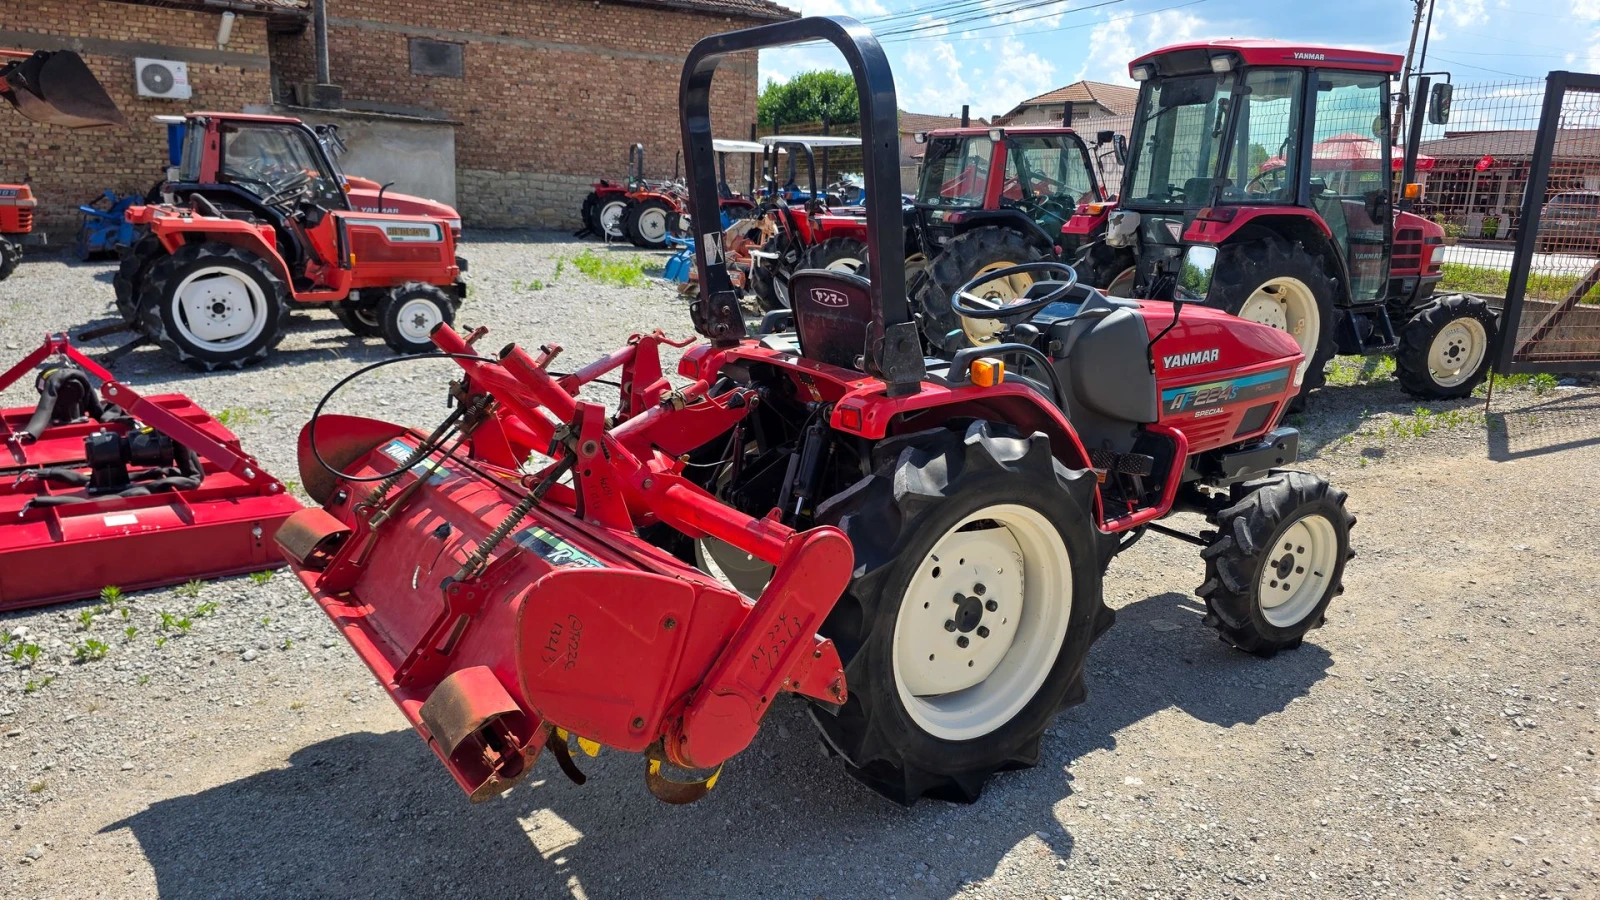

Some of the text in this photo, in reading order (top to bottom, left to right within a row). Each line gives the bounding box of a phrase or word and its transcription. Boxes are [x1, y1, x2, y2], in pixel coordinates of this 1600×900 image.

[1294, 52, 1325, 60] YANMAR
[815, 290, 843, 304] ヤンマー
[1163, 348, 1220, 369] YANMAR
[1194, 407, 1225, 418] SPECIAL
